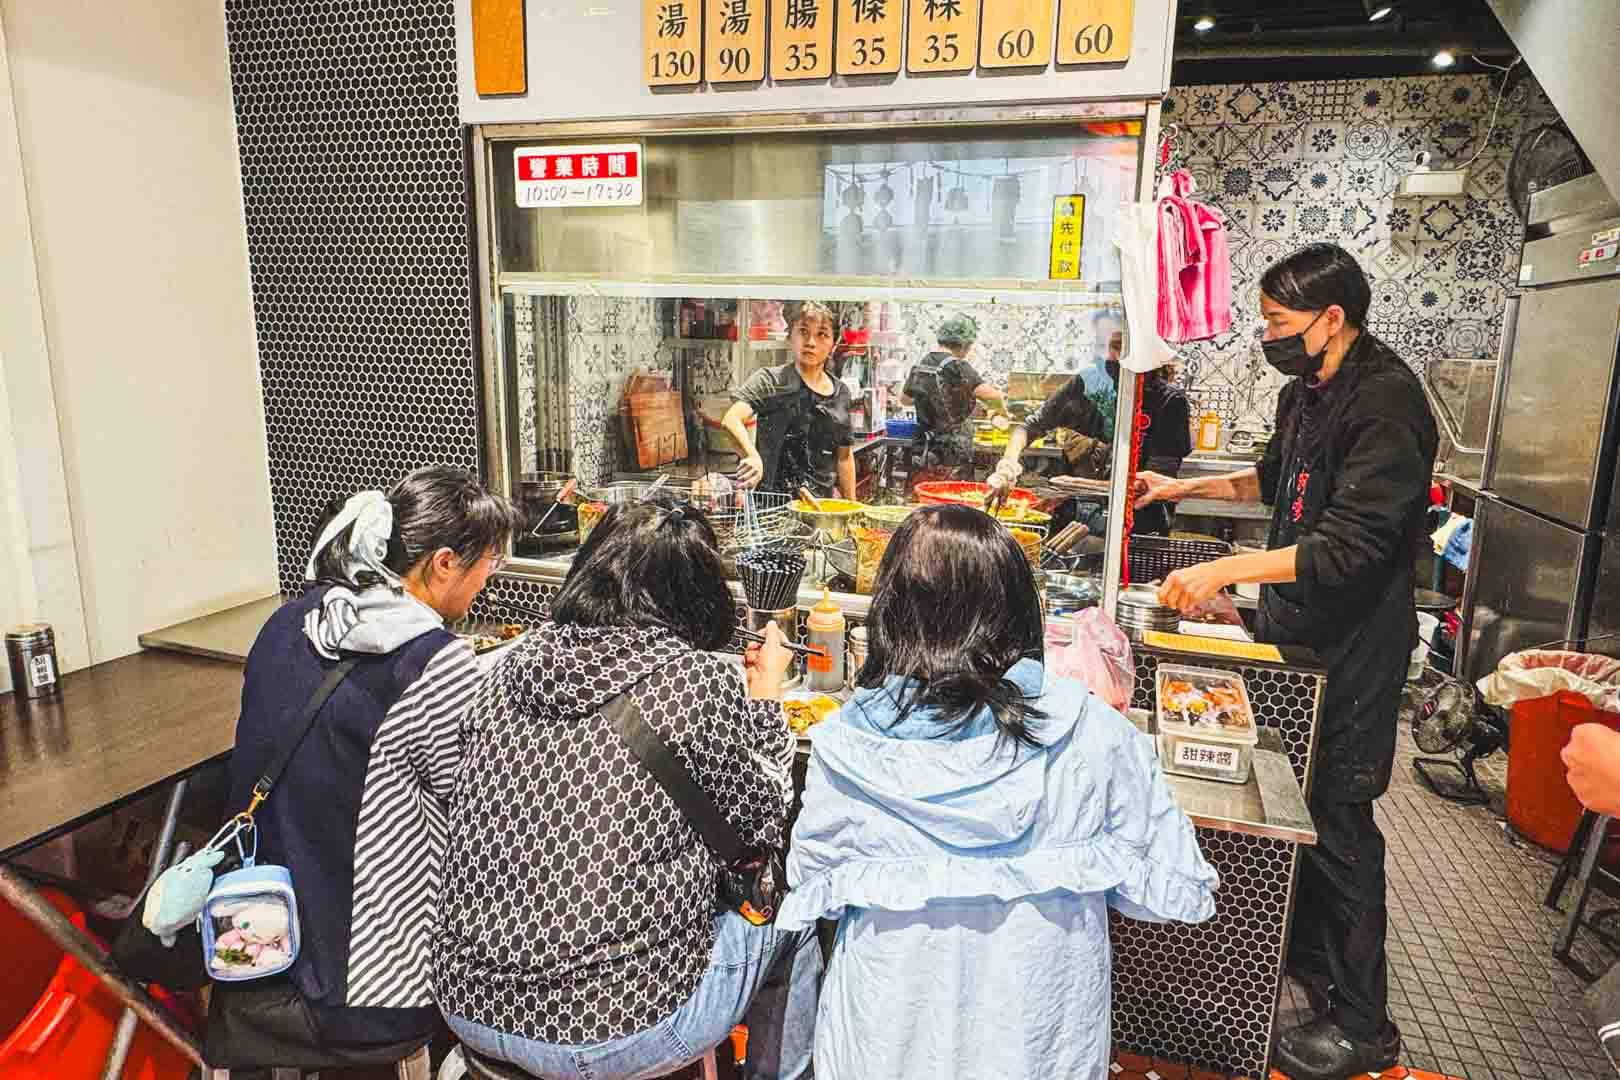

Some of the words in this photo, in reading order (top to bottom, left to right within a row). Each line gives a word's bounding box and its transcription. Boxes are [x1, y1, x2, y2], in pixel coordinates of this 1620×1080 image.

[656, 2, 689, 39] 湯
[719, 0, 752, 36] 湯
[851, 36, 886, 66] 35
[923, 33, 959, 63] 35
[997, 28, 1035, 59] 60
[1074, 23, 1114, 55] 60
[650, 50, 695, 79] 130
[719, 47, 751, 75] 90
[784, 43, 818, 72] 35
[528, 154, 627, 179] 營業時間
